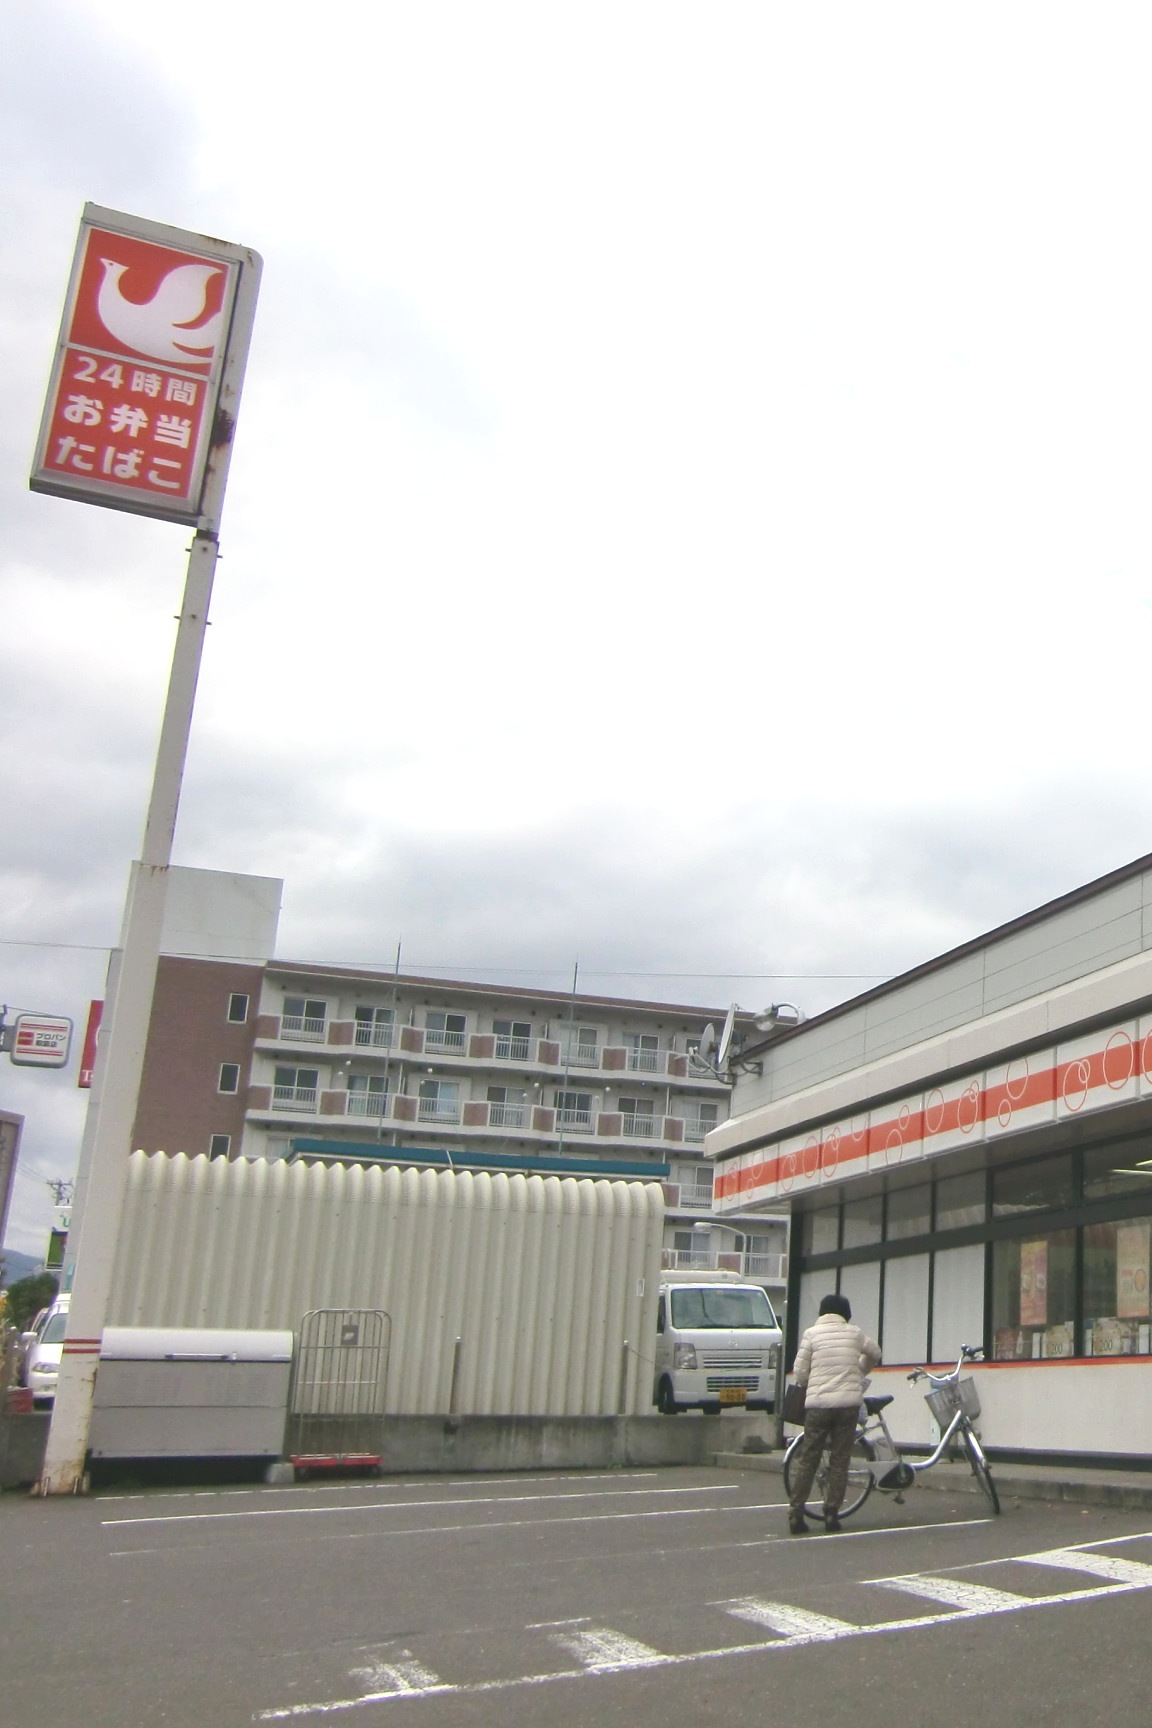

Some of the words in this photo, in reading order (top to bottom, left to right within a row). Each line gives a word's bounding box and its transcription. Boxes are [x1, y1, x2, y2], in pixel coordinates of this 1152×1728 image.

[73, 356, 197, 406] 24時間
[64, 394, 193, 449] お弁当
[55, 435, 182, 489] たばこ
